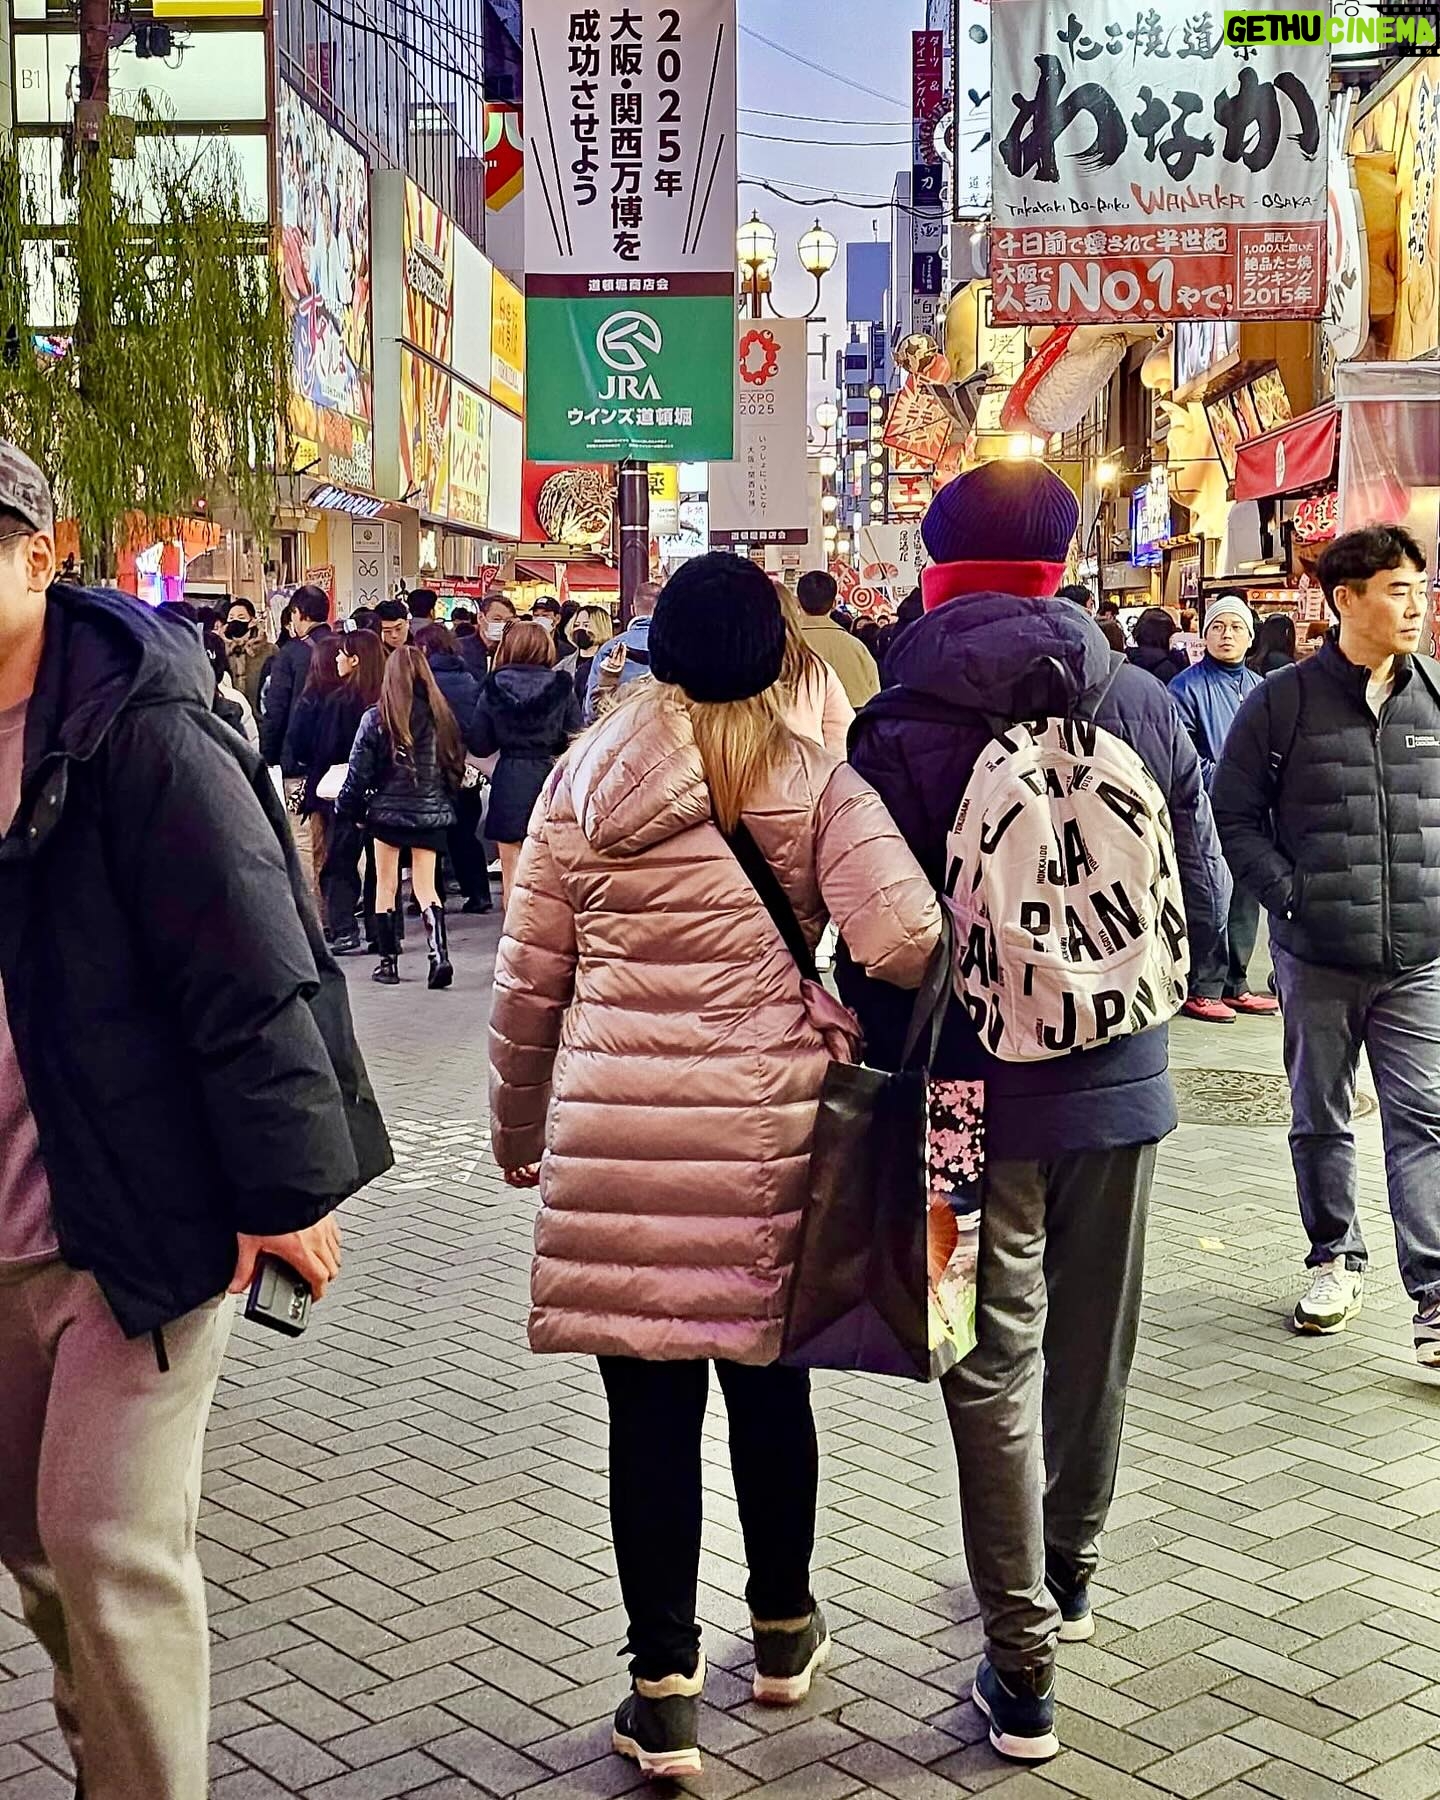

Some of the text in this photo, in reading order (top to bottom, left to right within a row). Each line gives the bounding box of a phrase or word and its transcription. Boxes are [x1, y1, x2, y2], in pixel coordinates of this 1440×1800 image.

[21, 69, 41, 89] B1
[567, 9, 601, 206] 成功させよう
[654, 8, 682, 198] 2025年
[998, 53, 1319, 183] わなか
[610, 8, 643, 261] 大阪・関西万博を
[997, 227, 1228, 257] 千日前で愛されて半世紀
[996, 262, 1053, 285] 大阪で
[1244, 255, 1313, 272] 絶品たこ焼
[588, 278, 669, 292] 道頓堀商店会
[1243, 269, 1316, 288] ランキング
[996, 283, 1053, 313] 人気
[1243, 285, 1313, 305] 2015年
[598, 373, 662, 400] JRA
[740, 393, 775, 403] EXPO
[567, 406, 693, 426] ウインズ道頓堀
[740, 404, 775, 415] 2025
[1036, 844, 1048, 885] HOKKAIDO
